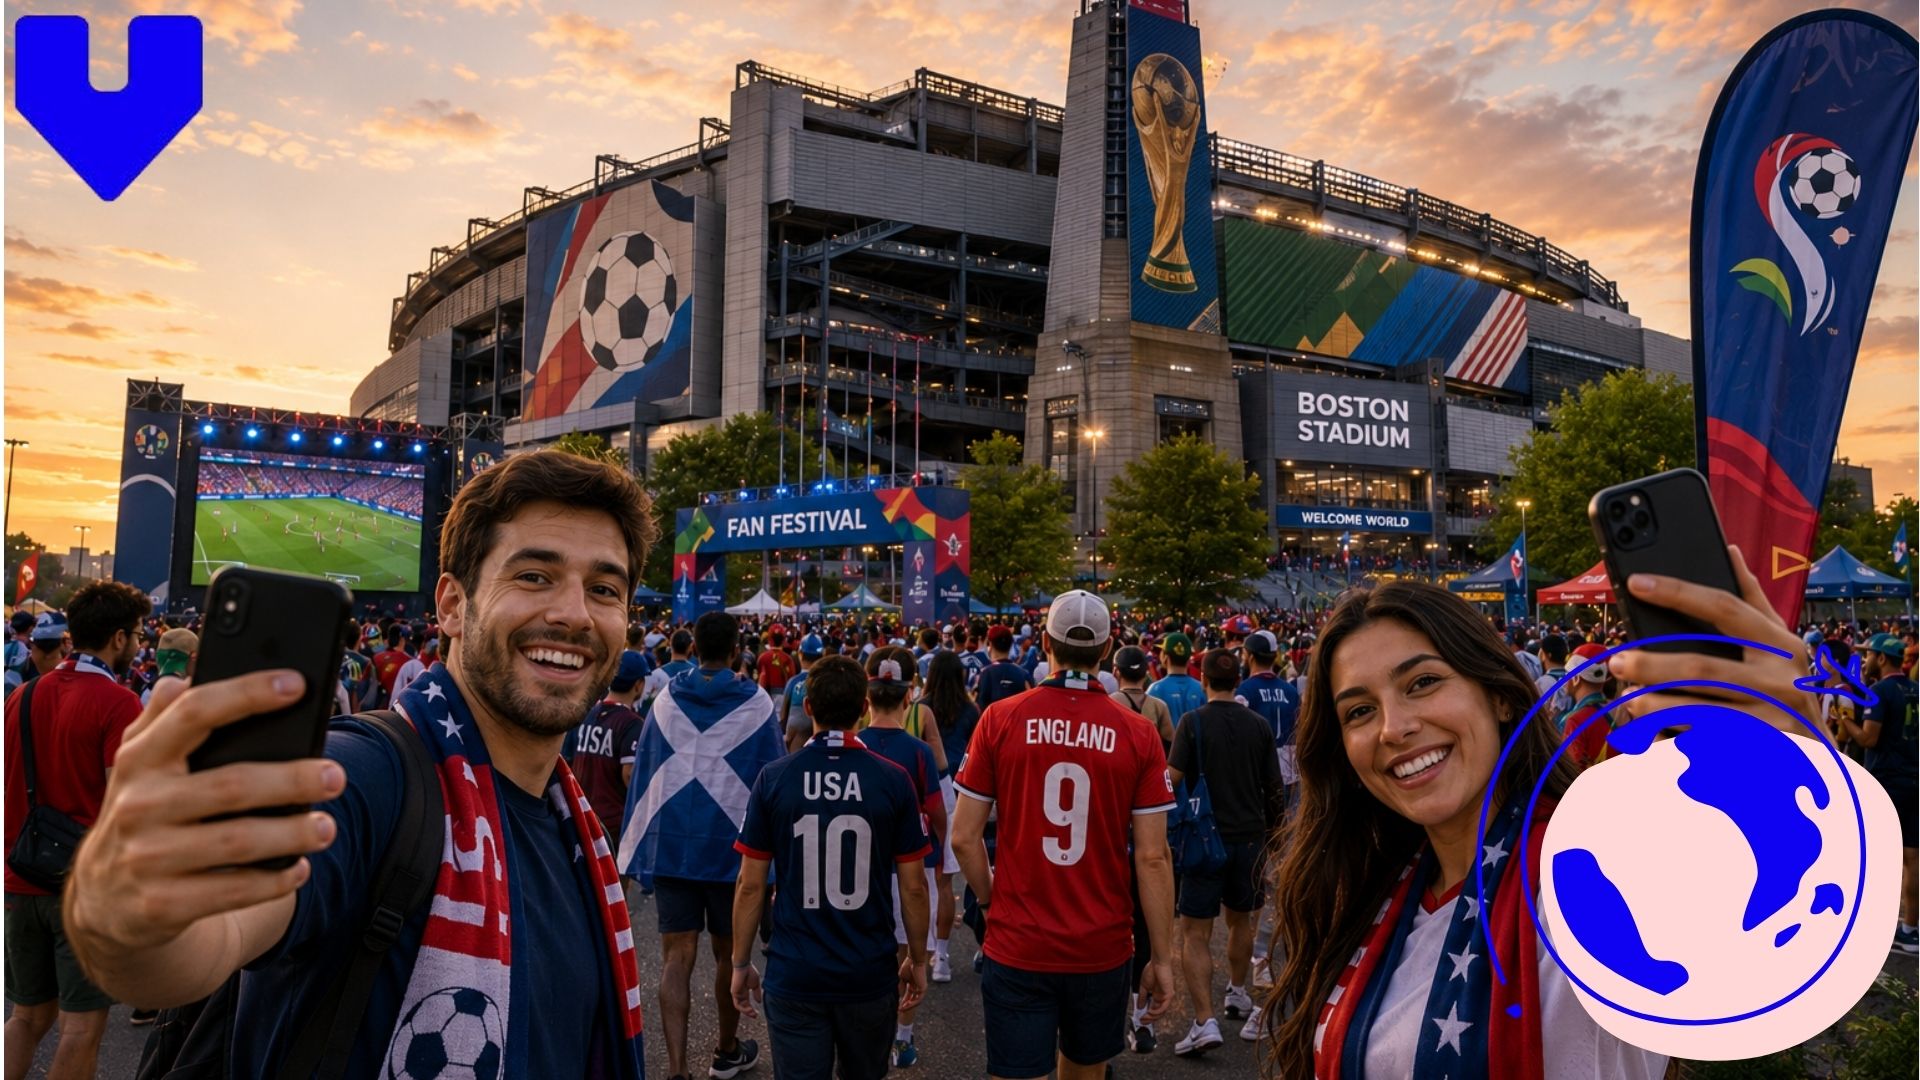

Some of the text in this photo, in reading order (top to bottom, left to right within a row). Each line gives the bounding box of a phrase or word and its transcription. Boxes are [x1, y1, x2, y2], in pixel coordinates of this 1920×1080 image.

[1298, 391, 1409, 422] BOSTON
[1298, 420, 1410, 449] STADIUM
[727, 508, 867, 538] FAN FESTIVAL
[1301, 511, 1410, 527] WELCOME WORLD
[577, 724, 614, 757] USA
[1025, 718, 1116, 753] ENGLAND
[803, 771, 863, 802] USA
[1042, 761, 1091, 866] 9
[793, 814, 872, 910] 10
